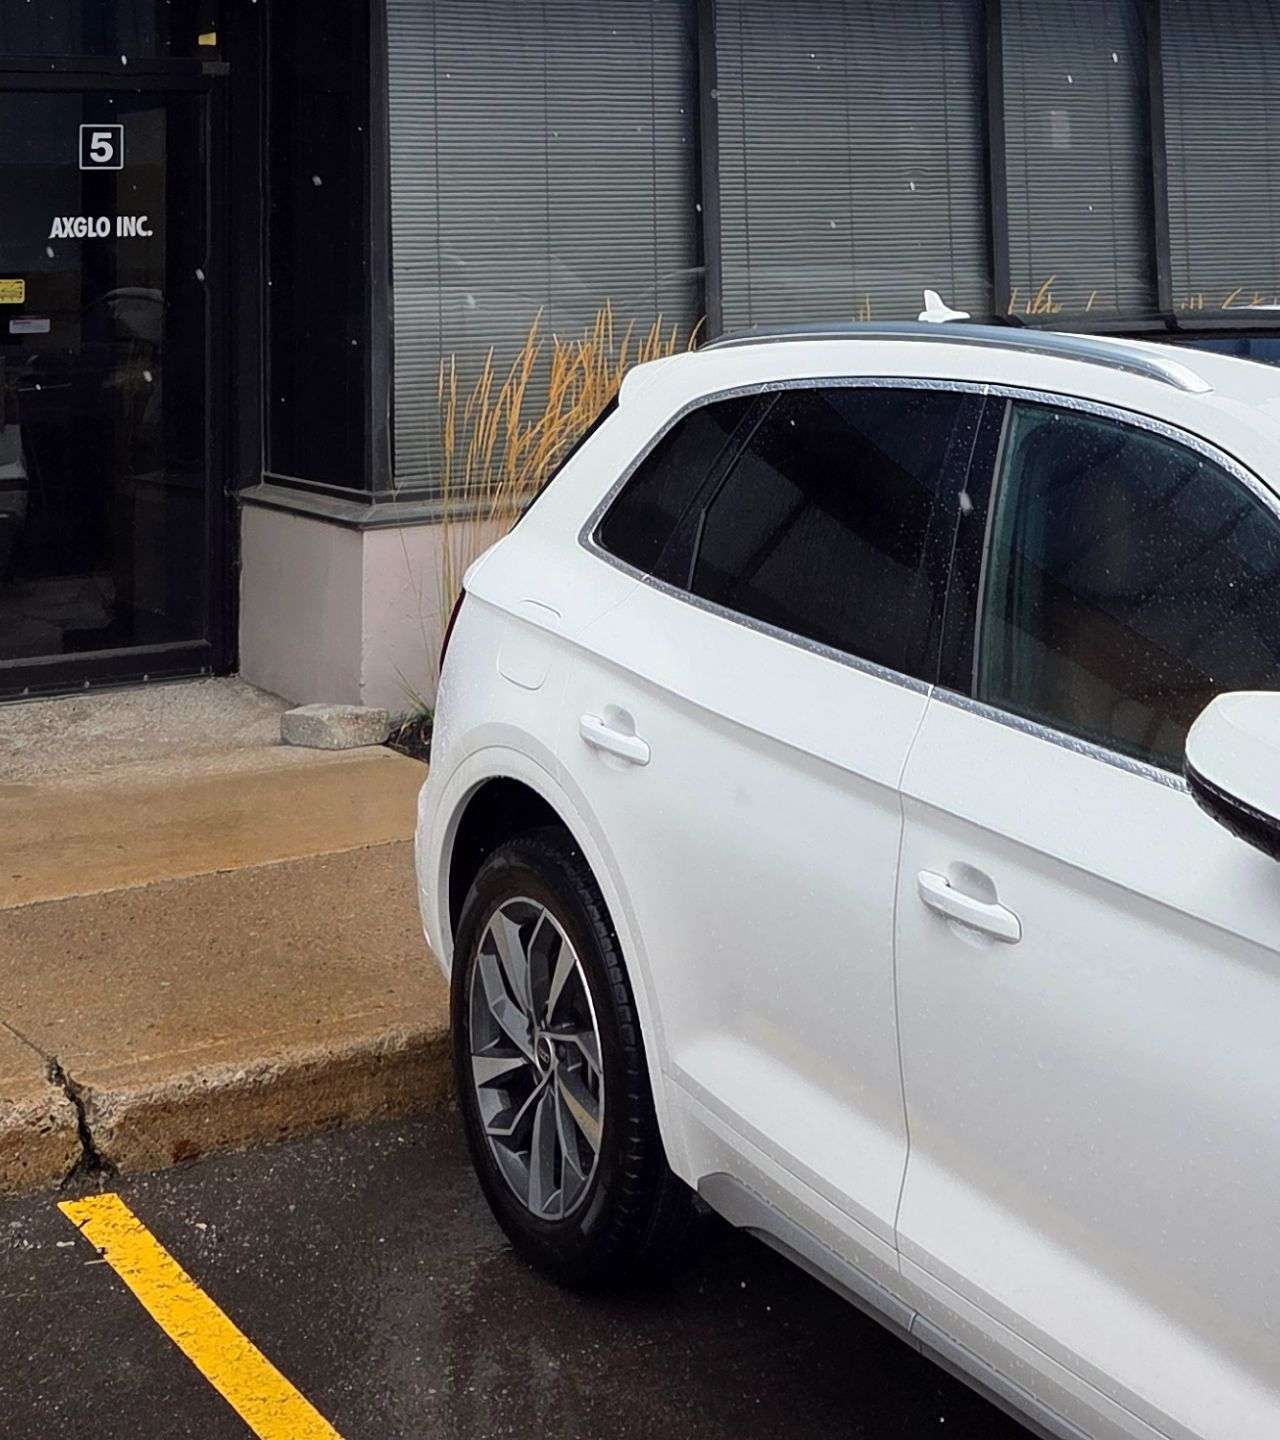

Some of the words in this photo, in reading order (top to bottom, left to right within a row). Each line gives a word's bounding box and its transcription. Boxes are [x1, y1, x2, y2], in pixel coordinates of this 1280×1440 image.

[90, 132, 114, 163] 5
[48, 216, 111, 238] AXGLO
[116, 216, 153, 237] INC.
